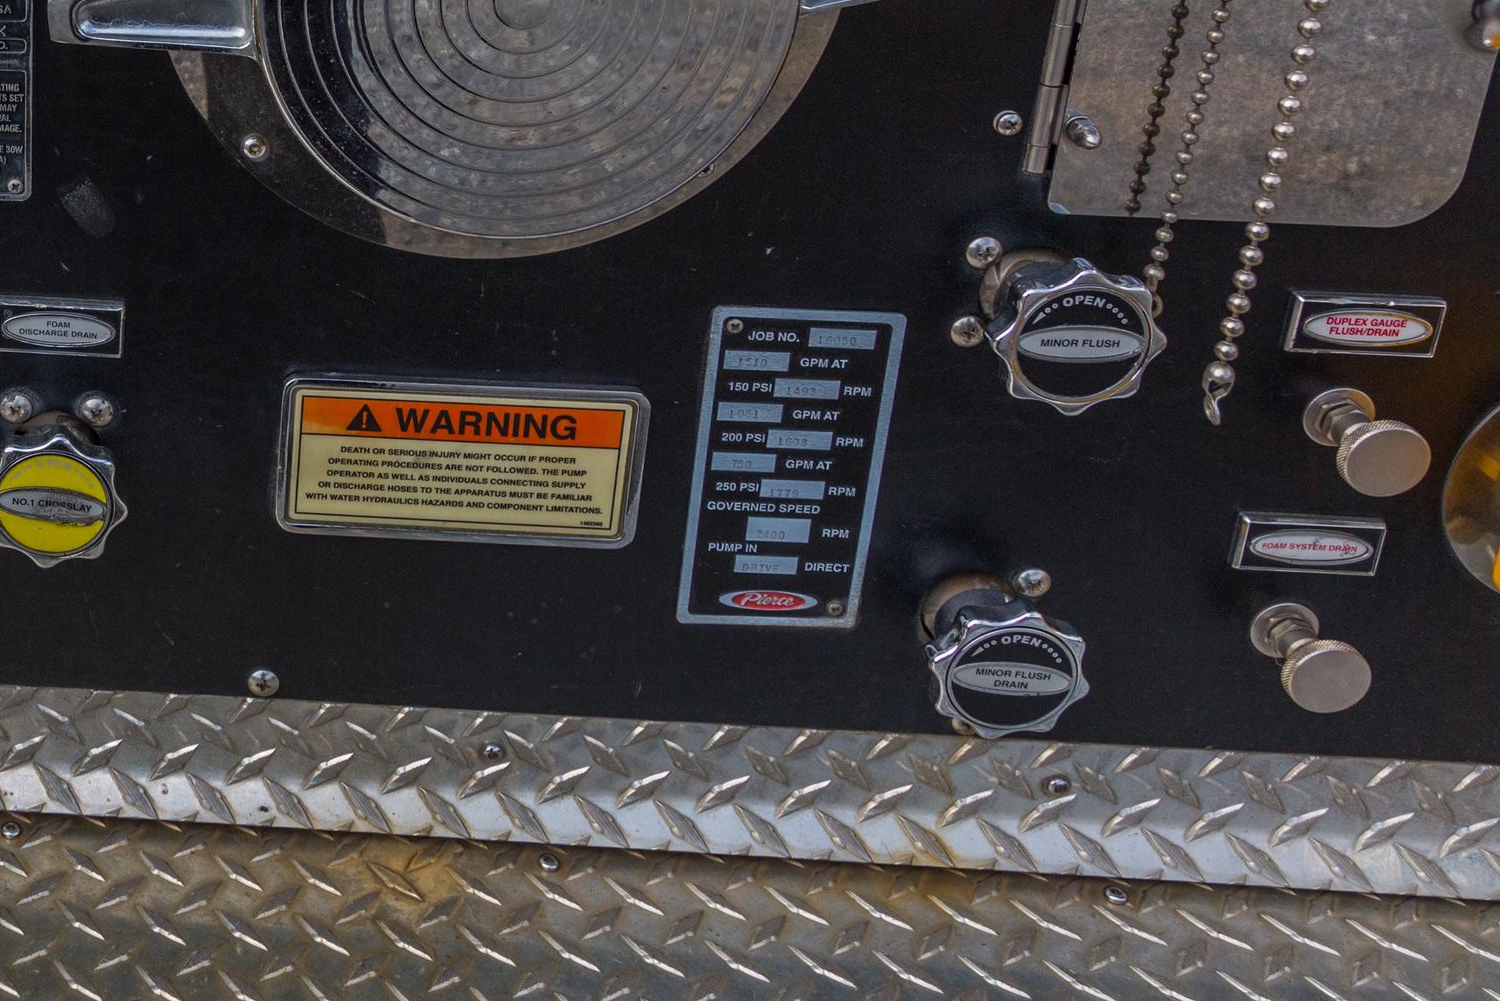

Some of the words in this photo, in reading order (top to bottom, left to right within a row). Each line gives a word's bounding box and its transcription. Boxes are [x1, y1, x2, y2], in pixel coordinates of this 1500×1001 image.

[1063, 295, 1105, 308] OPEN
[1326, 317, 1369, 326] DUPLEX
[1371, 318, 1407, 328] GAUGE
[19, 328, 68, 337] DISCHARGE
[71, 331, 97, 339] DRAIN
[748, 331, 774, 341] JOB
[778, 332, 800, 342] NO.
[1329, 328, 1399, 337] FLUSH/DRAIN
[1041, 339, 1079, 348] MINOR
[1082, 339, 1120, 348] FLUSH
[800, 358, 829, 368] GPM
[831, 359, 848, 368] AT
[728, 382, 749, 391] 150
[752, 383, 772, 392] PSI
[844, 386, 872, 396] RPM
[793, 410, 821, 420] GPM
[823, 411, 840, 420] AT
[396, 407, 577, 441] WARNING
[722, 433, 743, 442] 200
[746, 433, 766, 443] PSI
[836, 438, 864, 447] RPM
[341, 446, 370, 455] DEATH
[372, 447, 386, 455] OR
[388, 448, 427, 458] SERIOUS
[429, 451, 461, 460] INJURY
[463, 452, 492, 461] MIGHT
[494, 454, 525, 462] OCCUR
[539, 455, 576, 464] PROPER
[328, 457, 379, 468] OPERATING
[381, 460, 442, 471] PROCEDURES
[444, 463, 462, 471] ARE
[465, 464, 484, 472] NOT
[486, 465, 539, 475] FOLLOWED.
[542, 468, 559, 476] THE
[561, 469, 587, 477] PUMP
[786, 460, 813, 469] GPM
[815, 461, 833, 470] AT
[716, 483, 737, 491] 250
[740, 483, 759, 492] PSI
[829, 487, 856, 496] RPM
[12, 498, 34, 506] NO.1
[38, 500, 92, 512] CROSSLAY
[305, 493, 328, 501] WITH
[330, 494, 360, 503] WATER
[362, 496, 419, 506] HYDRAULICS
[421, 498, 463, 508] HAZARDS
[466, 500, 485, 509] AND
[487, 501, 543, 512] COMPONENT
[546, 505, 603, 514] LIMITATIONS.
[707, 502, 776, 512] GOVERNED
[779, 504, 820, 514] SPEED
[822, 529, 850, 538] RPM
[708, 543, 742, 552] PUMP
[745, 544, 758, 552] IN
[1262, 542, 1288, 550] FOAM
[1289, 543, 1326, 551] SYSTEM
[1328, 544, 1357, 552] DRAIN
[804, 563, 850, 572] DIRECT
[741, 593, 794, 607] Pierce
[1001, 635, 1042, 647] OPEN
[976, 668, 1012, 677] MINOR
[1015, 671, 1051, 680] FLUSH
[994, 680, 1028, 689] DRAIN
